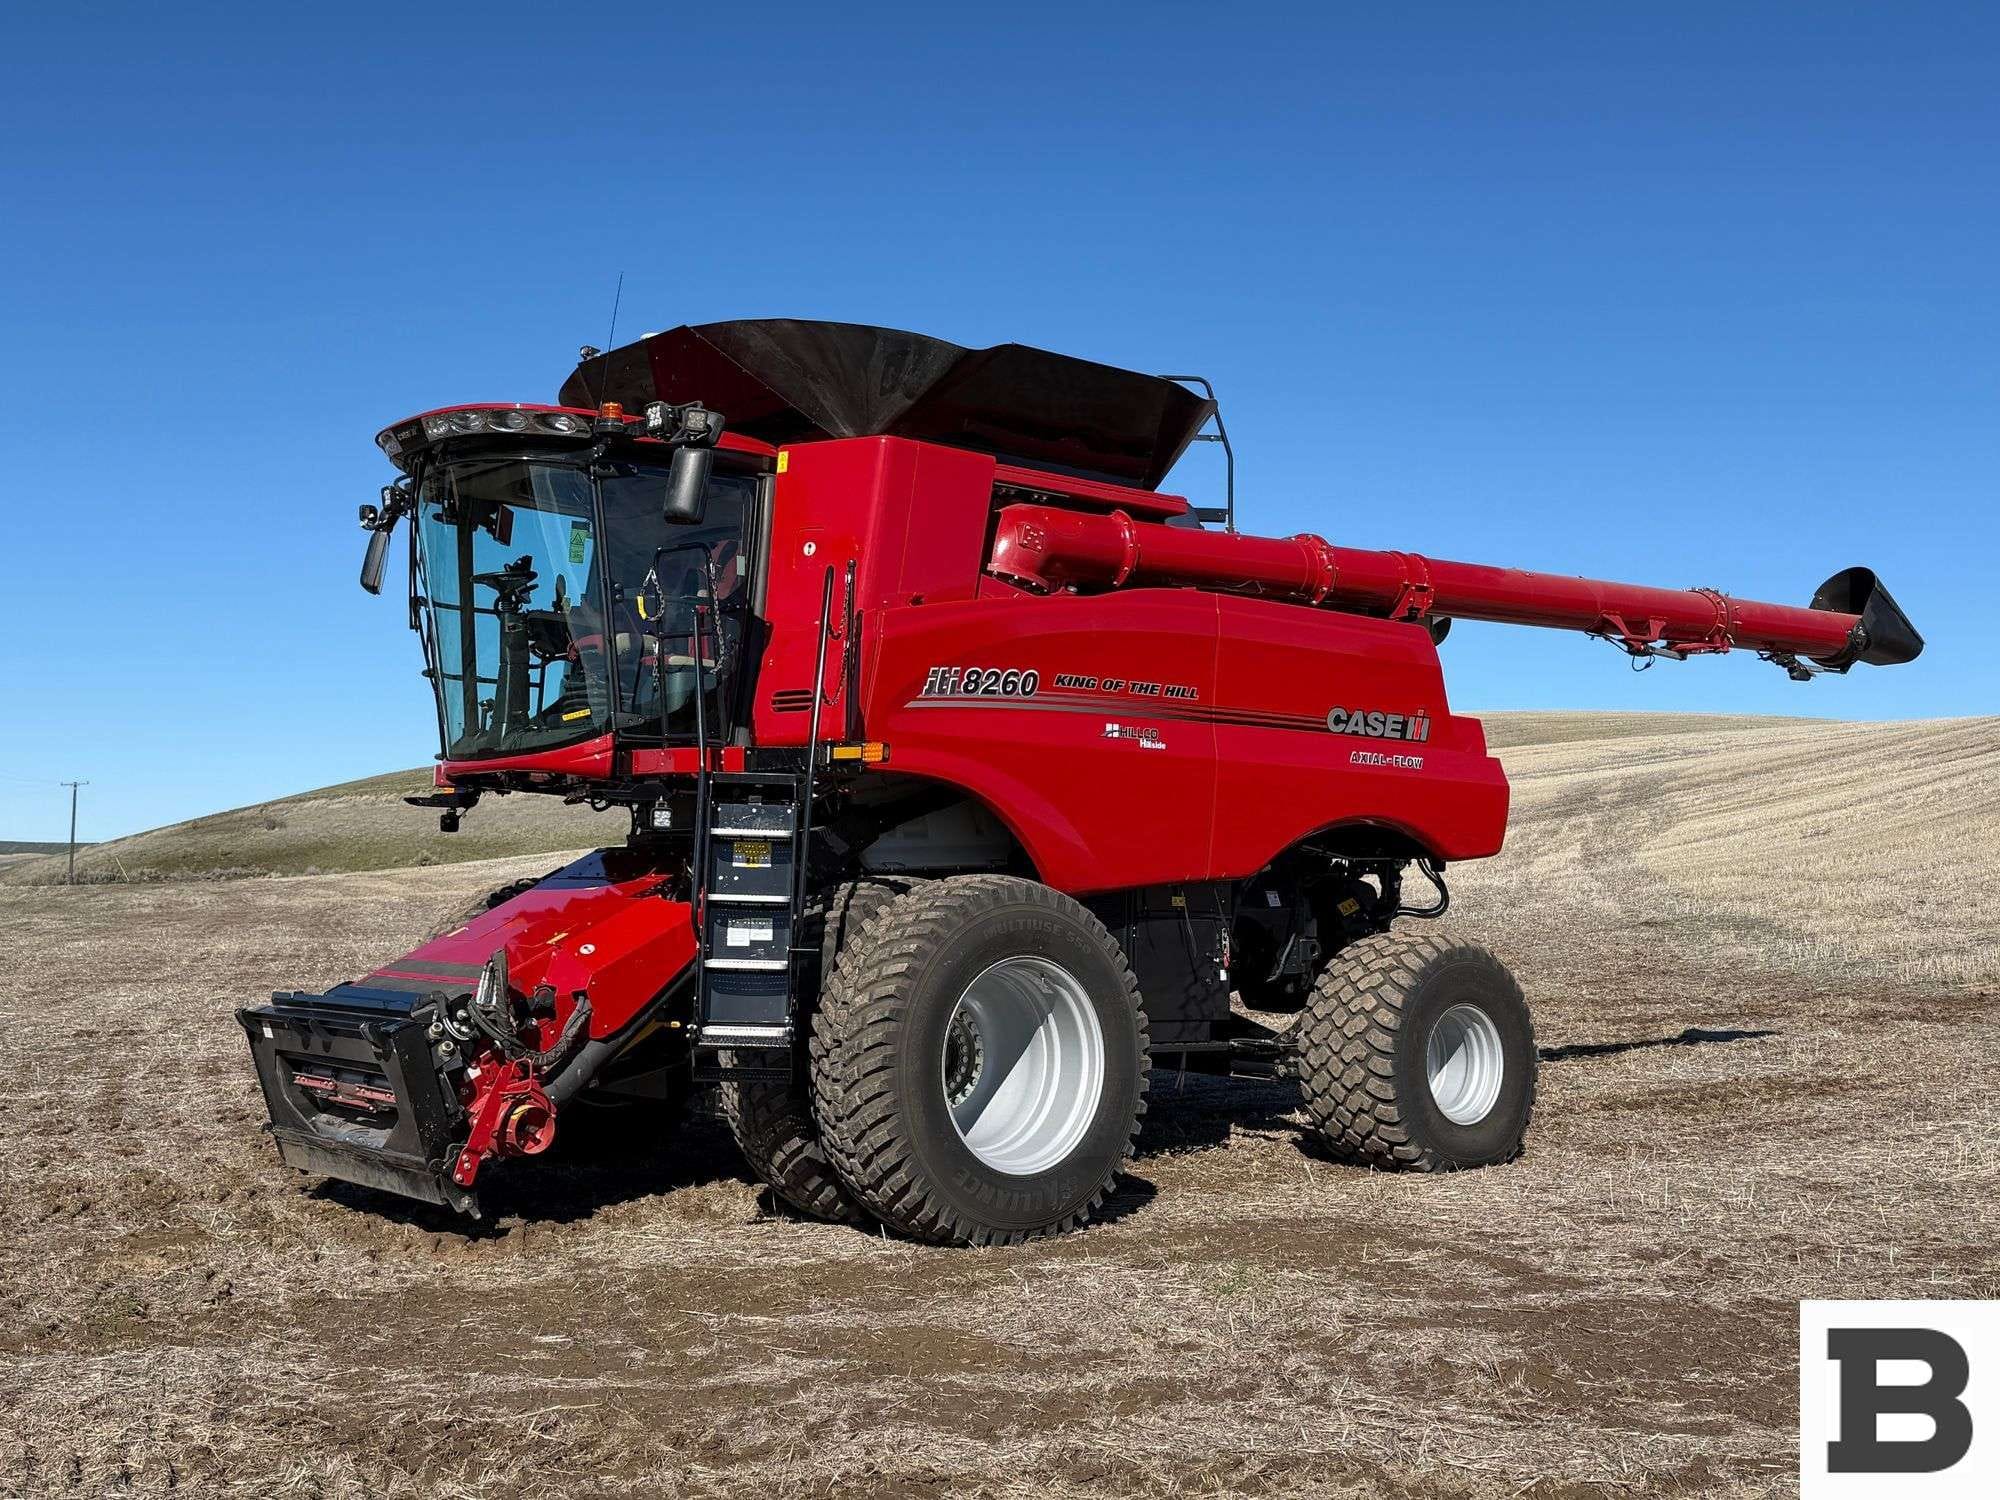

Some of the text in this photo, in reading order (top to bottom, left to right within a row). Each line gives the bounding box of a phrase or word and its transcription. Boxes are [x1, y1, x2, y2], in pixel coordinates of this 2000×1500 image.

[961, 668, 1039, 697] 8260
[1054, 674, 1200, 700] KING OF THE HILL
[1119, 726, 1159, 740] HILLCO
[1350, 751, 1424, 770] AXIAL-FLOW
